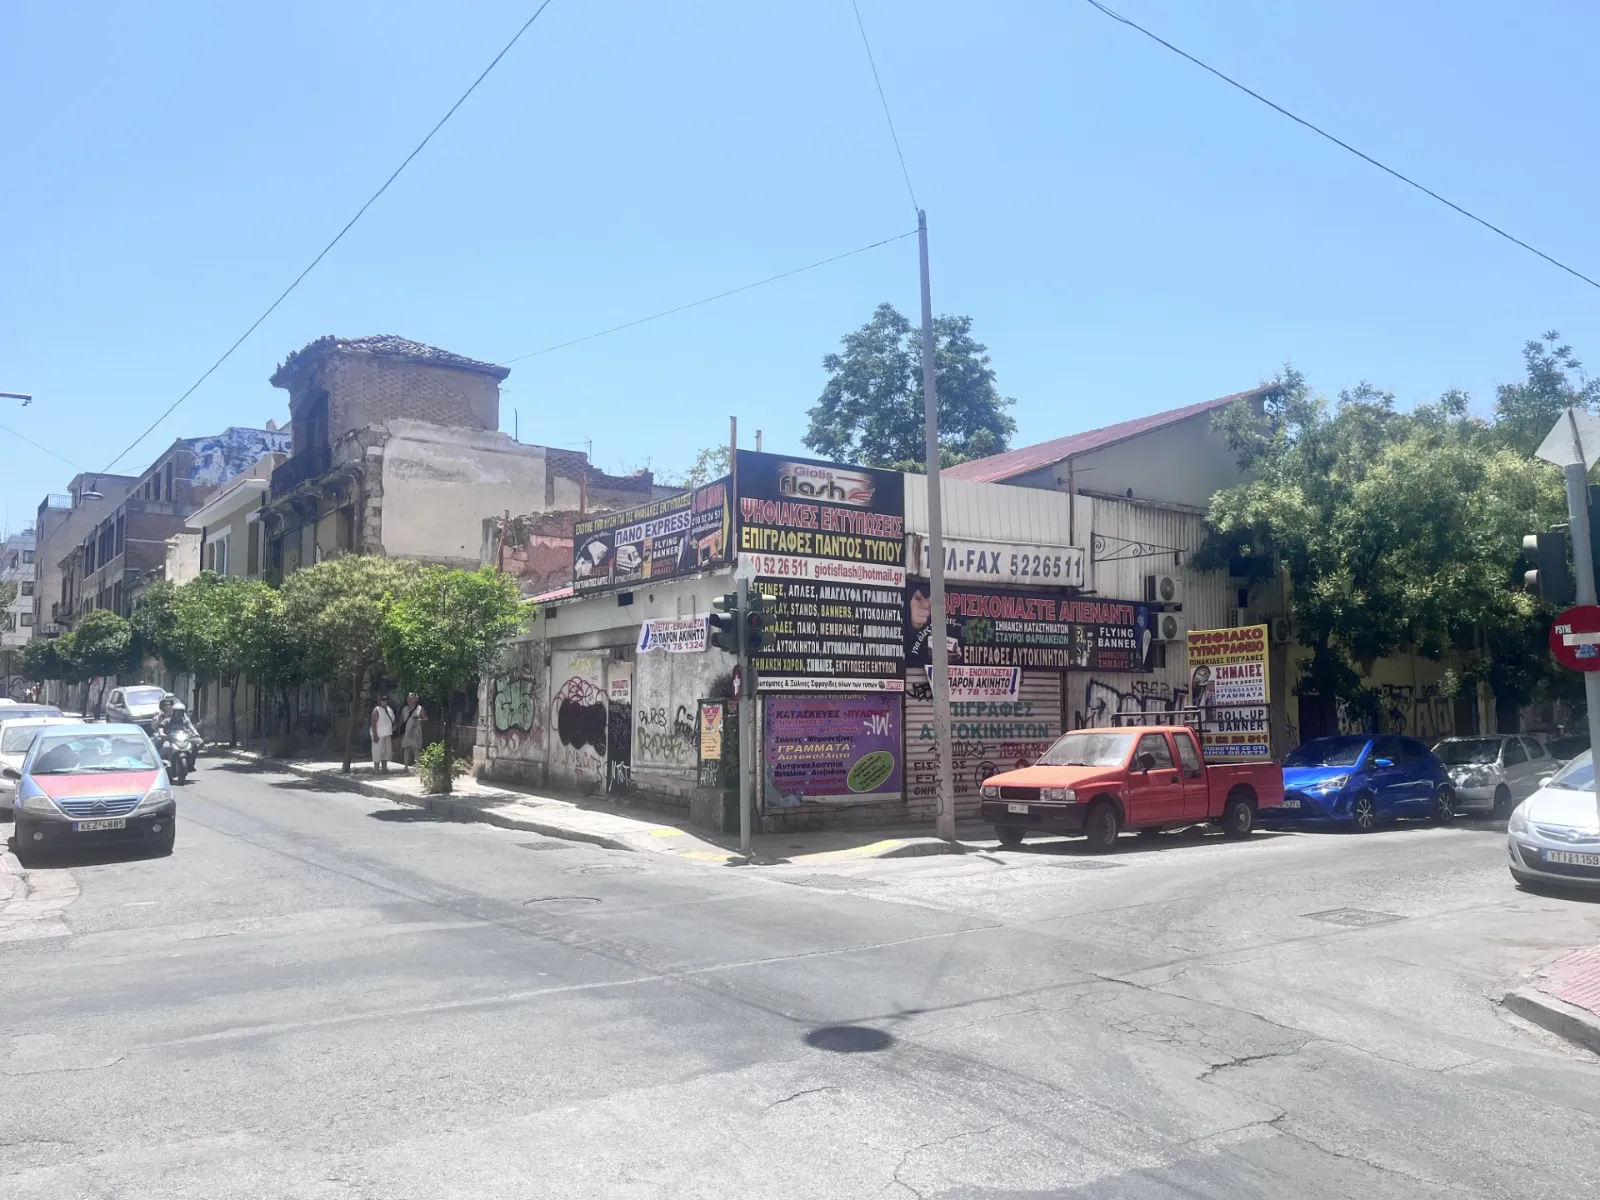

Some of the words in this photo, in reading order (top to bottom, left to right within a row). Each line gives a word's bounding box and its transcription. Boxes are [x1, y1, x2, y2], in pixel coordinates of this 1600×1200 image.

[794, 466, 833, 480] Giotis
[780, 474, 846, 500] flash
[645, 512, 690, 538] EXPRESS
[740, 498, 818, 530] ΨΗΦΙΑΚΕΣ
[820, 506, 903, 539] ΕΚΤΥΠΩΣΕΙΣ
[654, 536, 678, 550] FLYING
[742, 526, 812, 554] ΕΠΙΓΡΑΦΕΣ
[815, 534, 862, 558] ΠΑΝΤΟΣ
[865, 540, 902, 563] ΤΥΠΟΥ
[653, 546, 678, 559] BANNER
[924, 546, 1001, 574] ΤΛ-FAX
[1010, 554, 1081, 578] 5226511
[764, 558, 775, 574] 52
[778, 558, 789, 576] 26
[792, 560, 808, 577] 511
[814, 562, 903, 585] giotisflash@hotmail.gr
[750, 582, 786, 598] ΤΕΙΝΕΣ,
[788, 584, 818, 601] ΑΠΛΕΣ,
[820, 586, 861, 601] ΑΝΑΓΛΥΦΑ
[791, 603, 820, 618] STANDS,
[821, 605, 854, 620] BANNERS,
[855, 607, 903, 624] ΑΥΤΟΚΟΛΛΗΤΑ,
[1059, 603, 1135, 625] ΑΠΕΝΑΝΤΙ
[797, 622, 818, 637] ΠΑΝΟ,
[820, 623, 862, 639] ΜΕΜΒΡΑΝΕΣ,
[996, 621, 1023, 632] ΣΗΜΑΝΣΗ
[1024, 622, 1068, 634] ΚΑΤΑΣΤΗΜΑΤΩΝ
[1100, 627, 1134, 638] FLYING
[658, 631, 678, 643] ΠΑΡΟΝ
[679, 629, 704, 642] ΑΚΙΝΗΤΟ
[996, 632, 1024, 643] ΣΤΑΥΡΟΙ
[1098, 638, 1136, 648] BANNER
[1188, 628, 1263, 645] ΨΗΦΙΑΚΟ
[685, 641, 703, 649] 1324
[777, 640, 822, 656] ΑΥΤΟΚΙΝΗΤΩΝ,
[1189, 640, 1264, 657] ΤΥΠΟΓΡΑΦΕΙΟ
[964, 646, 1010, 665] ΕΠΙΓΡΑΦΕΣ
[1012, 648, 1068, 666] ΑΥΤΟΚΙΝΗΤΩΝ
[1190, 658, 1224, 666] ΠΙΝΑΚΙΔΕΣ
[1226, 654, 1264, 663] ΕΠΙΓΡΑΦΕΣ
[948, 667, 964, 676] ΕΙΤΑΙ
[970, 668, 1012, 677] ΕΝΟΙΚΙΑΖΕΤΑΙ
[1216, 664, 1262, 680] ΣΗΜΑΙΕΣ
[758, 680, 784, 688] υτόματες
[976, 678, 1010, 688] ΑΚΙΝΗΤΟ
[776, 710, 840, 719] ΚΑΤΑΣΚΕΥΕΣ
[950, 702, 1034, 717] ΠΙΓΡΑΦΕΣ
[1218, 710, 1264, 720] ROLL-UP
[1219, 721, 1264, 732] BANNER
[778, 744, 850, 752] ΓΡΑΜΜΑΤΑ
